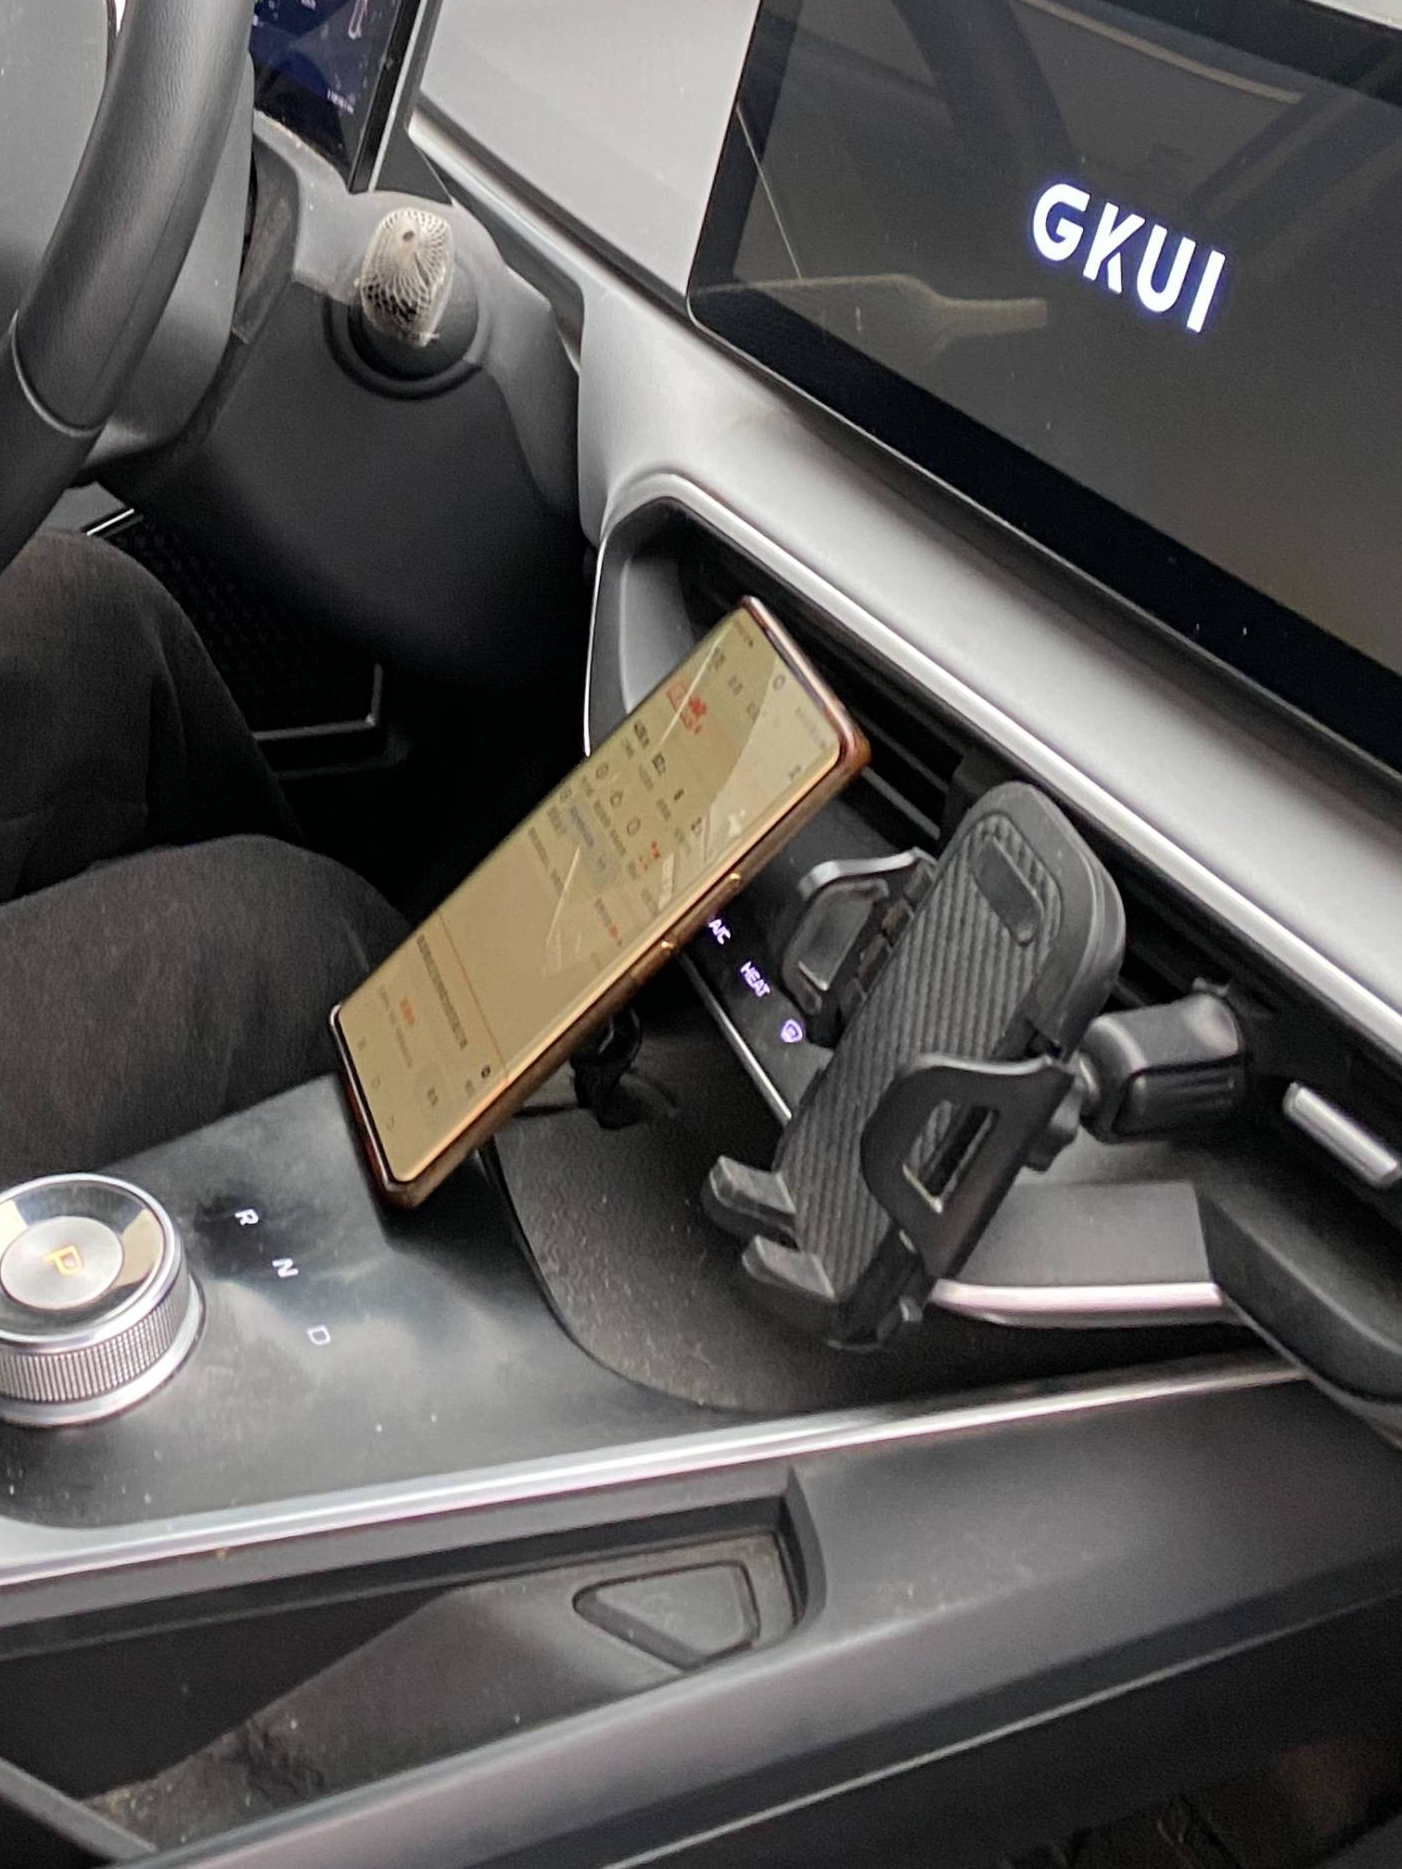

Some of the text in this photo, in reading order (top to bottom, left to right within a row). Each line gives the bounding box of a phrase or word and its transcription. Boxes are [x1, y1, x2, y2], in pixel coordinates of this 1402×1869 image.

[1033, 183, 1226, 333] GKUI
[709, 919, 771, 997] A/C HEAT
[43, 1244, 83, 1276] P
[234, 1208, 331, 1345] R N D
